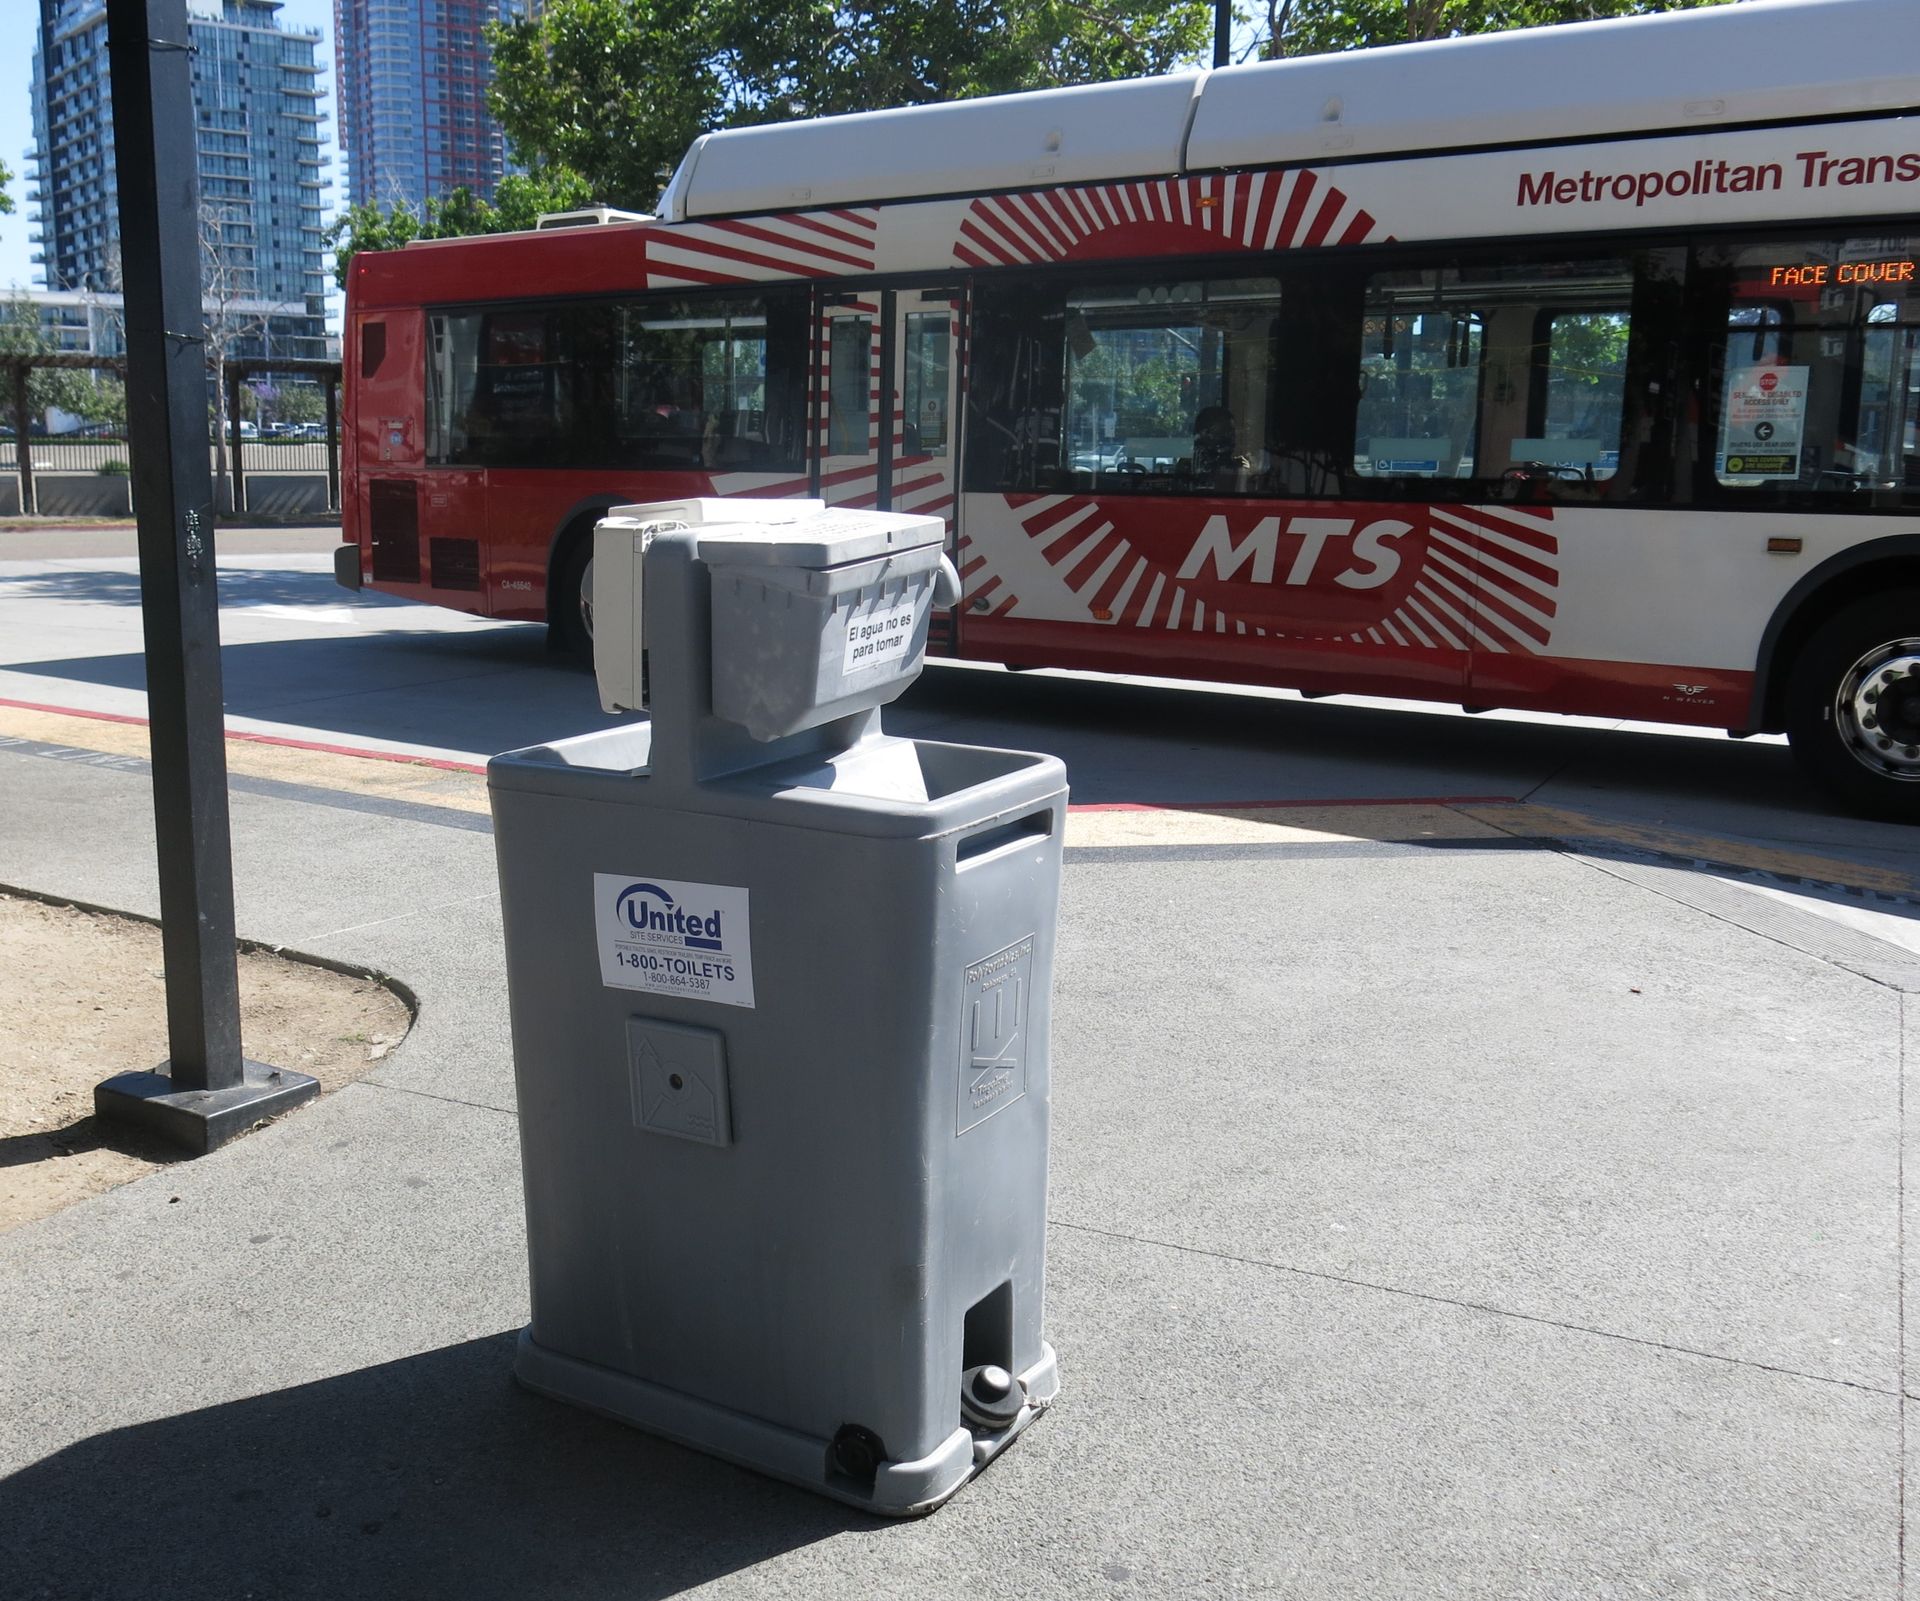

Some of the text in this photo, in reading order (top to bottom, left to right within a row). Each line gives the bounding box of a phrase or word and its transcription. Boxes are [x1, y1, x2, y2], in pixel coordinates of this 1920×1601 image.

[1516, 151, 1920, 207] Metropolitan Trans
[1771, 261, 1915, 285] FACE COVER
[1760, 378, 1778, 387] STOP
[1767, 390, 1802, 398] DISABLED
[1743, 398, 1771, 406] ACCESS
[1175, 514, 1415, 590] MTS
[849, 614, 912, 642] El agua no es
[852, 634, 904, 663] para tomar
[627, 899, 722, 938] United
[630, 930, 683, 945] SITE SERVICES
[616, 951, 735, 982] 1-800-TOILETS
[643, 971, 711, 990] 1-800-864-5387
